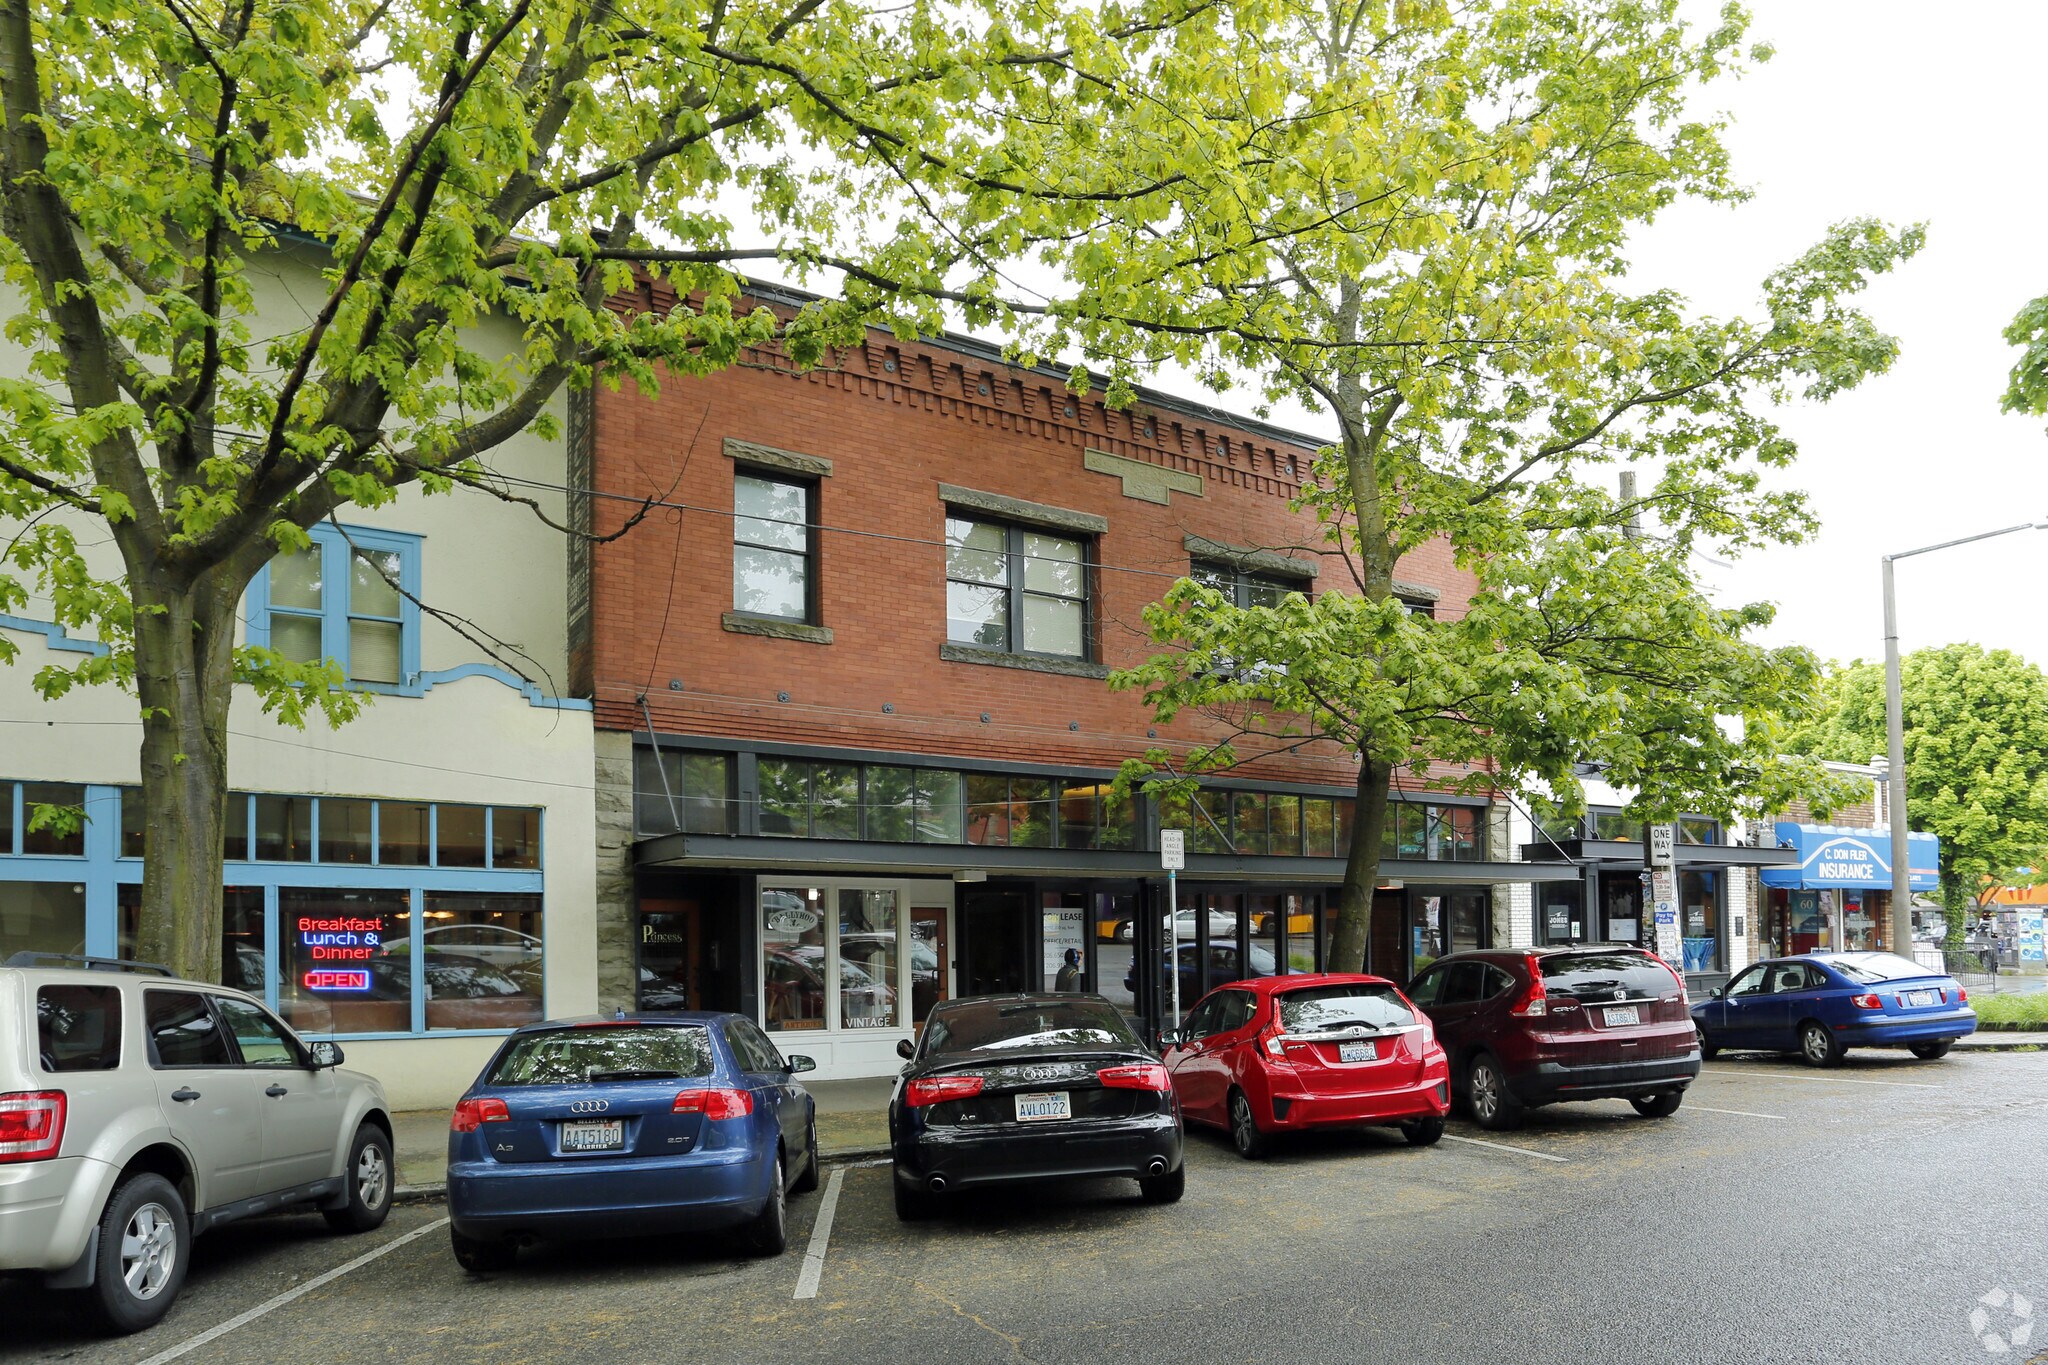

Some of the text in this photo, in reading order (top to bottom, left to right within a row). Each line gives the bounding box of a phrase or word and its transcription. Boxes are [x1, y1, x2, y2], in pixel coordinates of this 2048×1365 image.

[1653, 829, 1671, 838] ONE
[1653, 840, 1671, 849] WAY
[1825, 849, 1868, 861] C. DON FILER
[1818, 863, 1874, 879] INSURANCE
[1800, 899, 1814, 910] 60
[772, 911, 815, 924] BALLYHOO
[1060, 912, 1083, 921] LEASE
[298, 917, 382, 931] Breakfast
[303, 931, 380, 945] Lunch &
[312, 946, 373, 959] Dinner
[304, 972, 365, 987] OPEN
[846, 1017, 890, 1028] VINTAGE
[1020, 1101, 1066, 1116] AVL0122
[565, 1128, 619, 1146] AAT5180
[496, 1143, 514, 1151] A3
